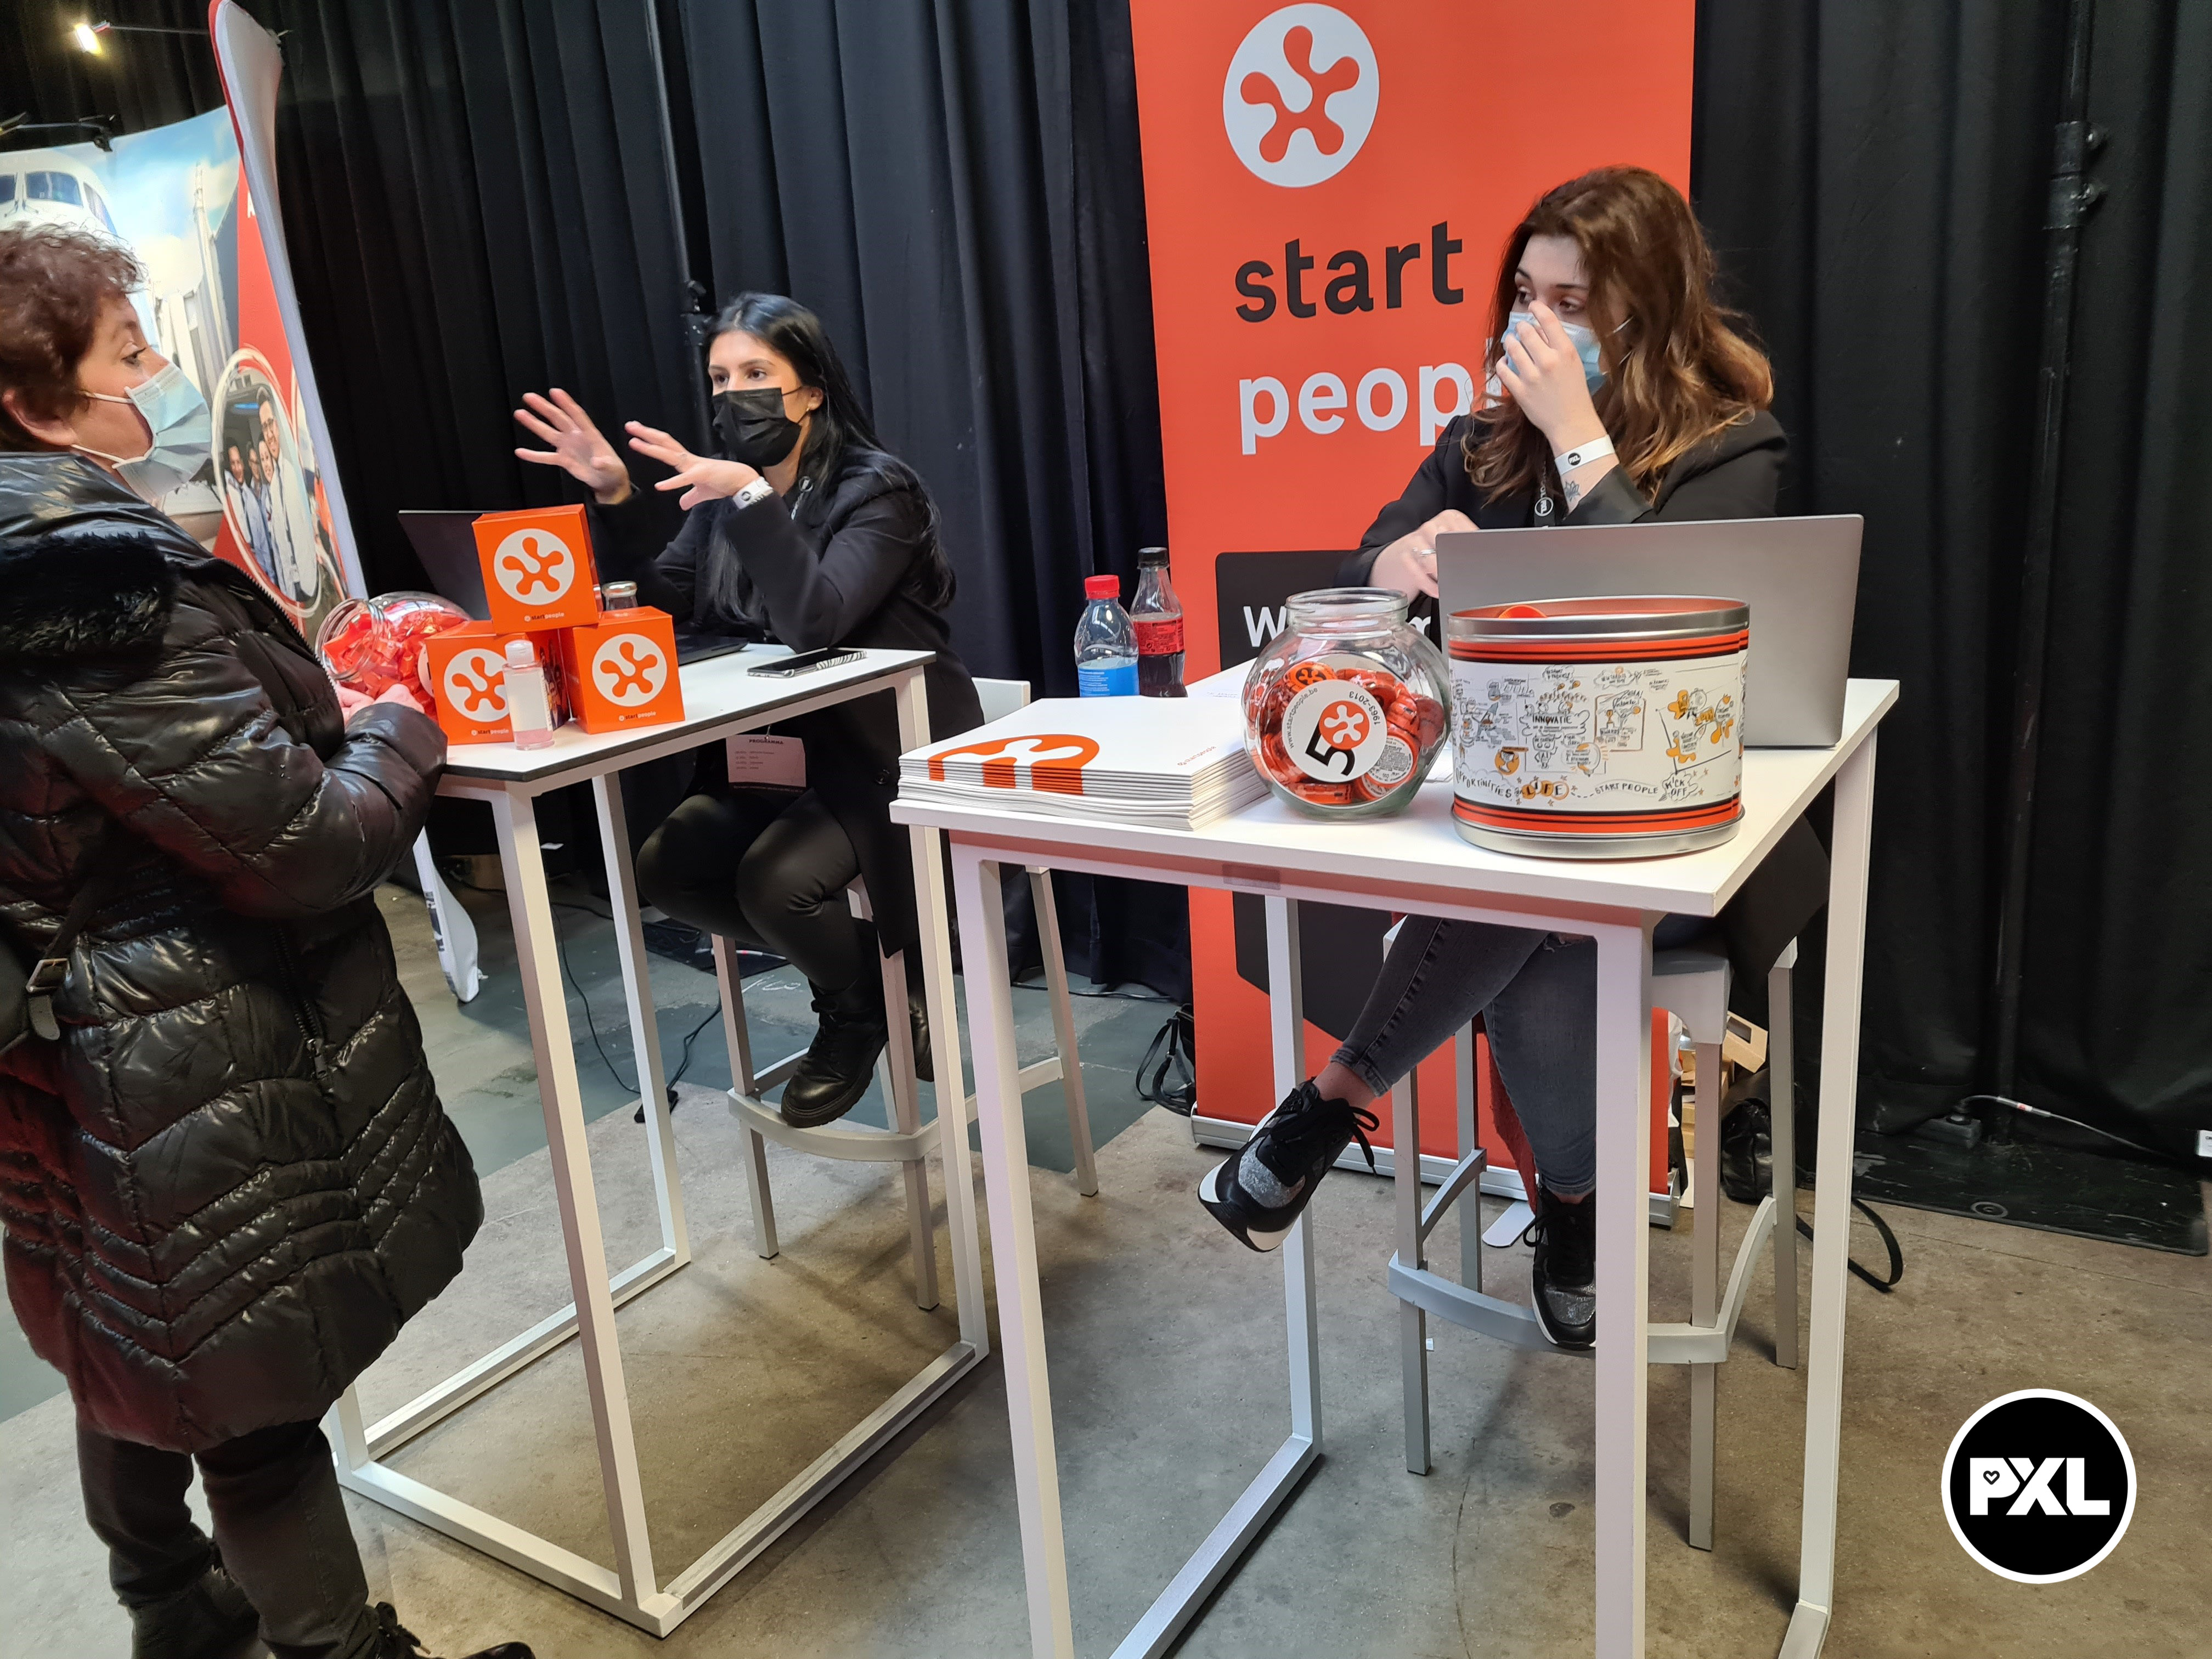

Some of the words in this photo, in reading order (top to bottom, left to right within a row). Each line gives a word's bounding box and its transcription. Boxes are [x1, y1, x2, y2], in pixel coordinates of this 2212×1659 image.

[1235, 221, 1464, 323] start
[1349, 691, 1380, 725] 1963-2013
[1532, 714, 1572, 724] INNOVATIE
[1595, 783, 1619, 794] START
[1622, 783, 1658, 794] PEOPLE
[1671, 787, 1687, 796] OFF
